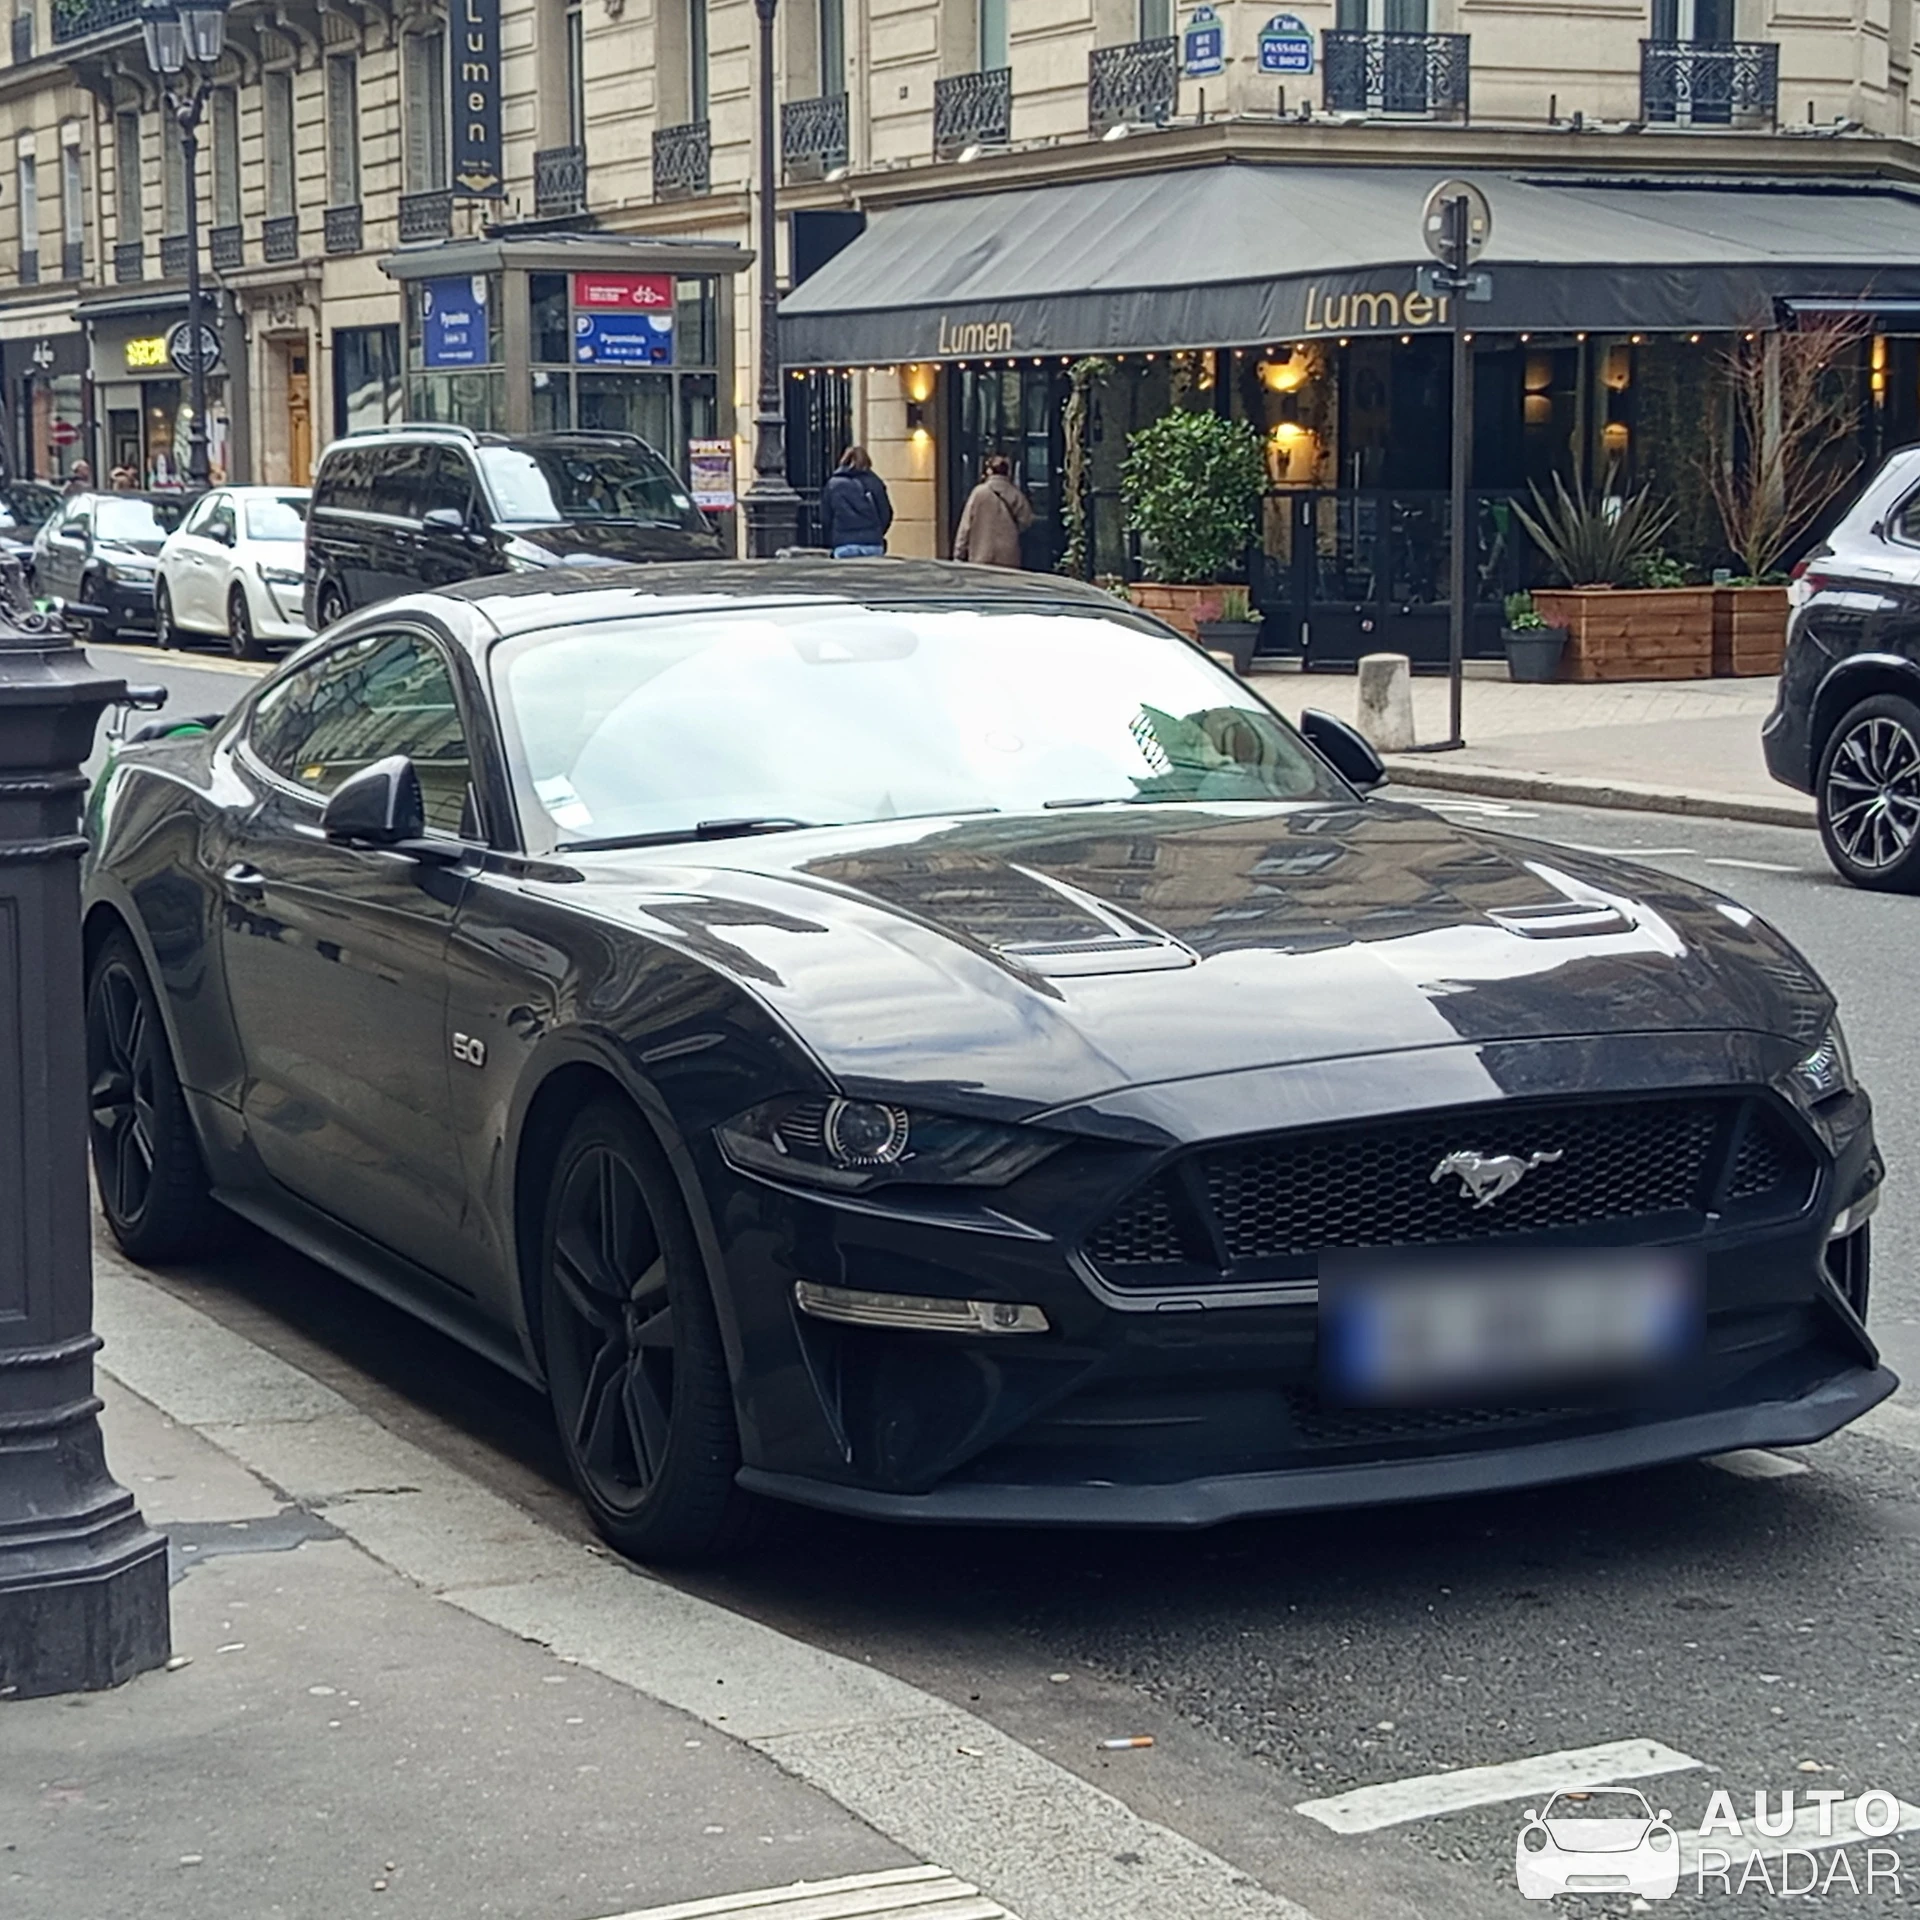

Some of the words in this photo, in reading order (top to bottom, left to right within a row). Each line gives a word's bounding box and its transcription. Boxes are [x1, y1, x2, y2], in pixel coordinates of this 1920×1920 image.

[1264, 42, 1307, 53] PASSAGE
[463, 0, 489, 142] Lumen
[938, 315, 1012, 354] Lumen
